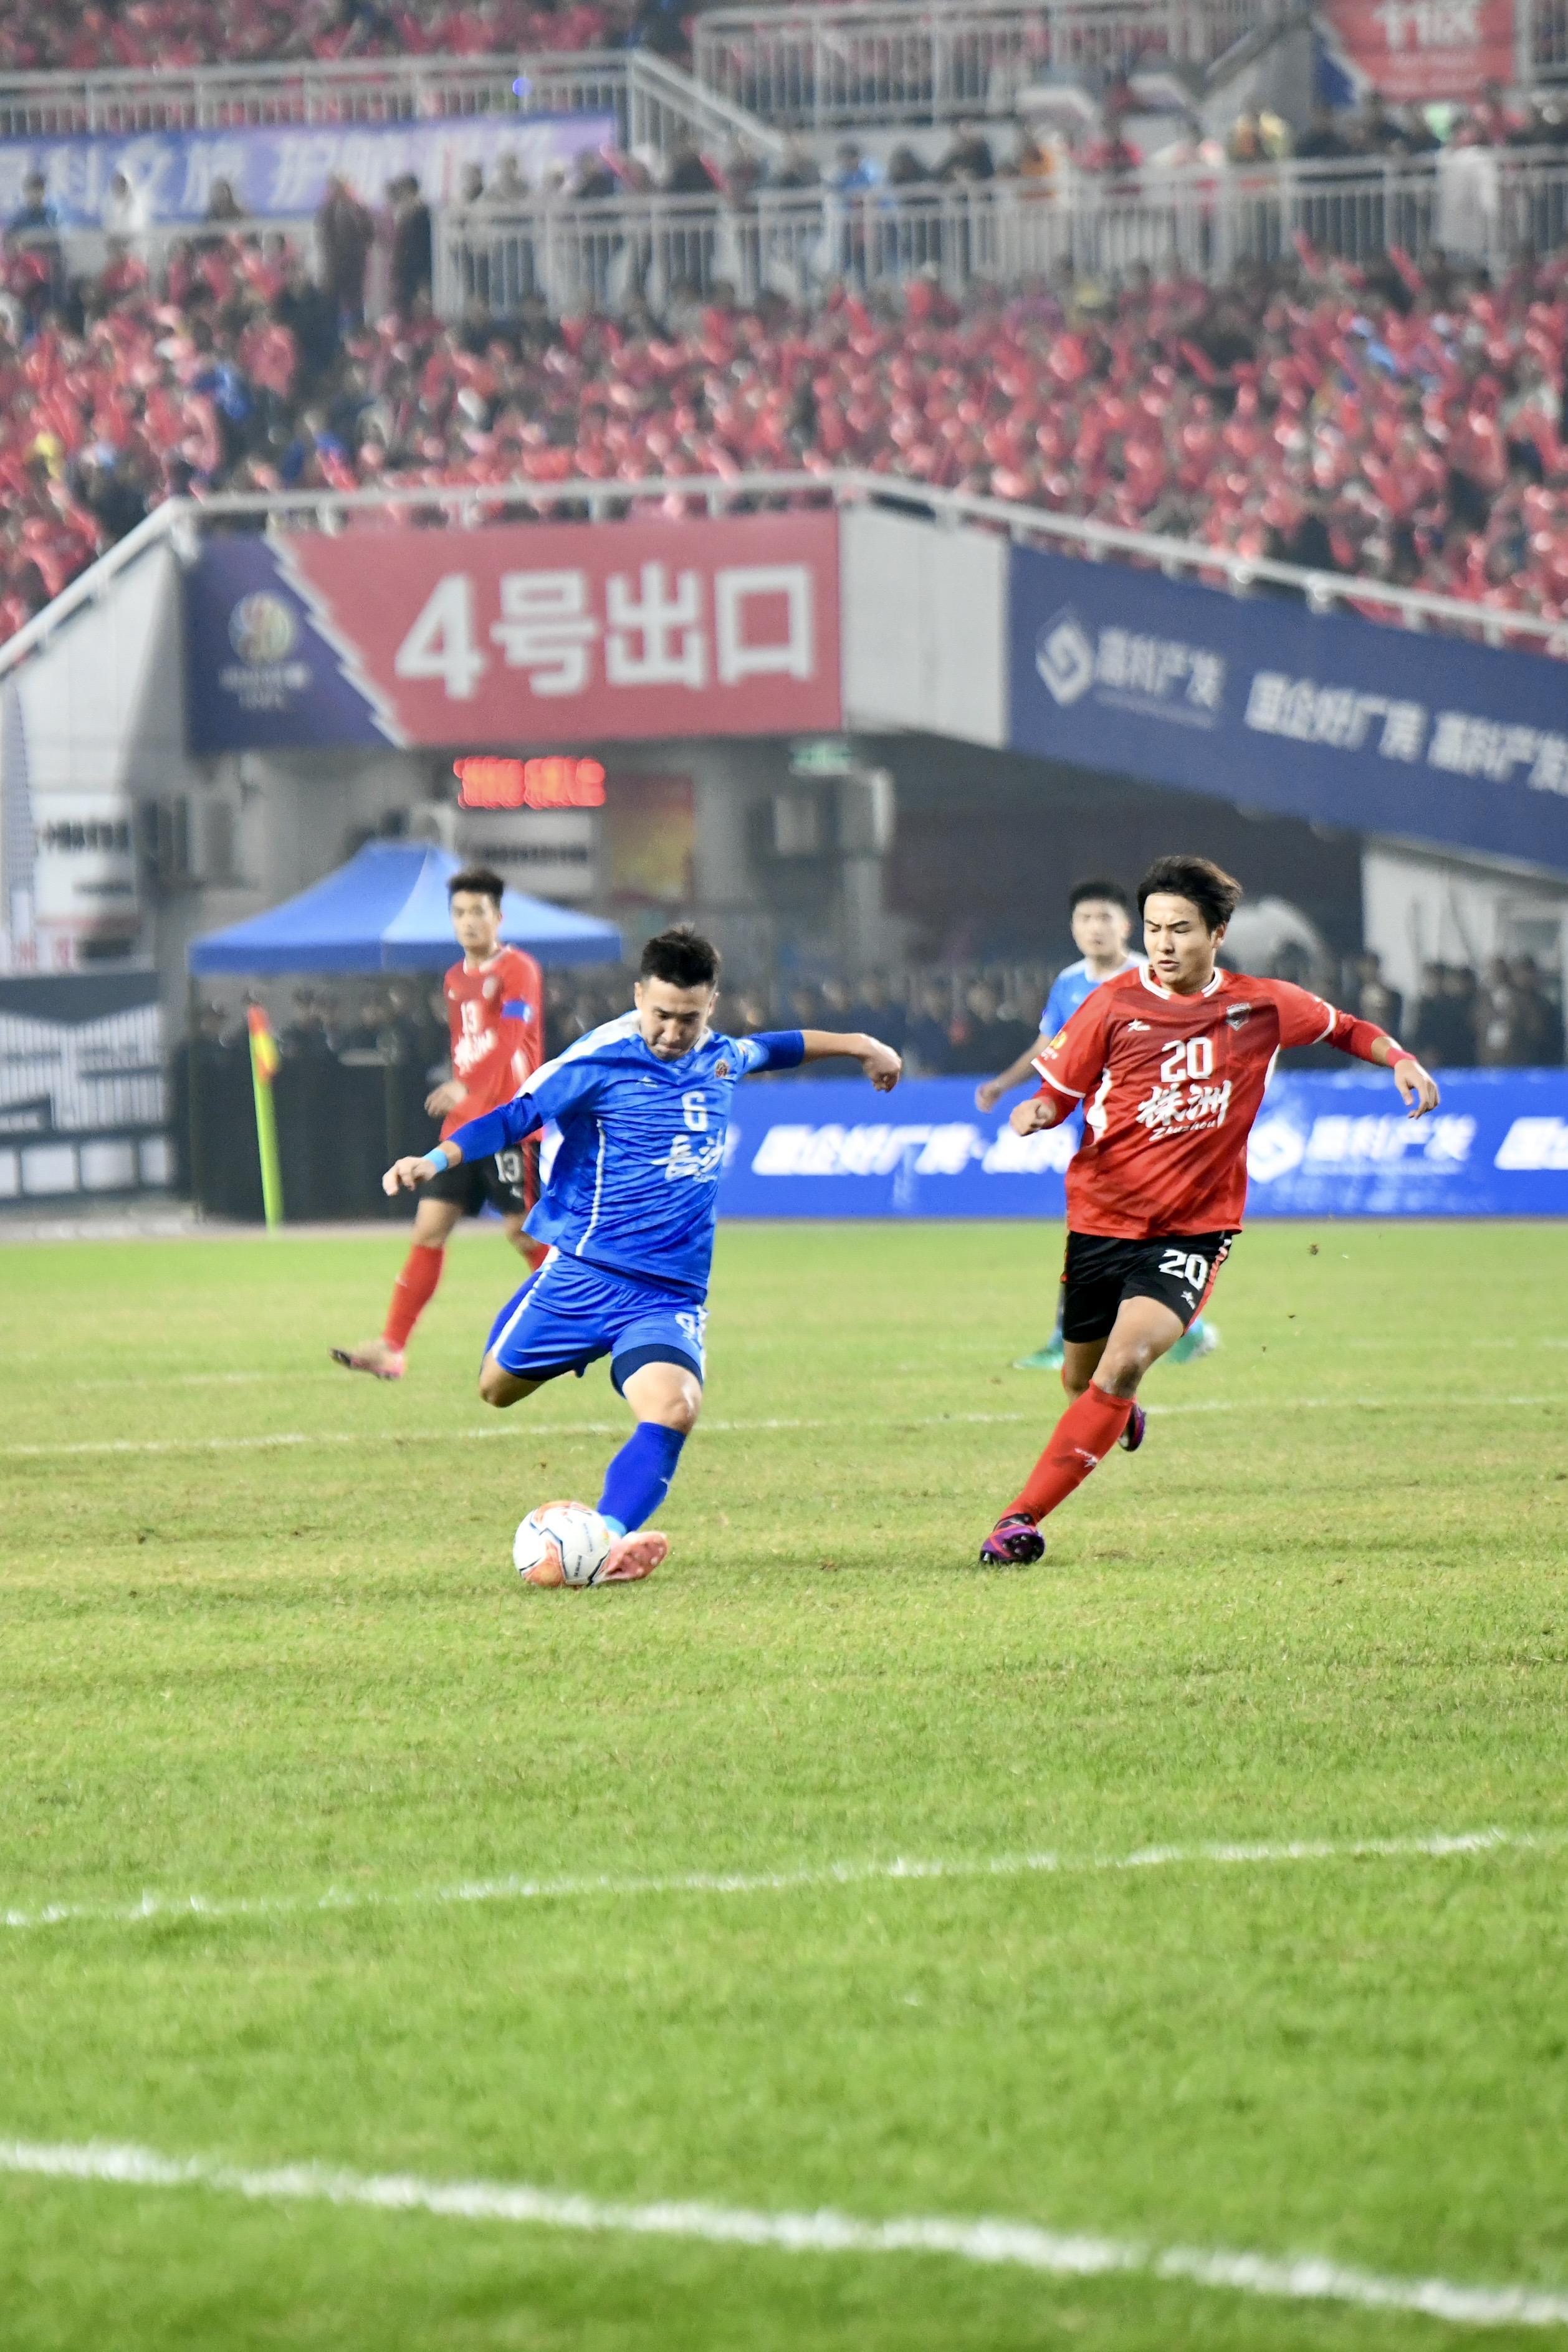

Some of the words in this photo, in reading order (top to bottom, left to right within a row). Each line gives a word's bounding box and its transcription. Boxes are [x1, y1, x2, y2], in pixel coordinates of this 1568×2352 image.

[393, 560, 812, 699] 4号出口
[461, 1000, 480, 1036] 13
[1160, 1036, 1214, 1083] 20
[682, 1090, 709, 1132] 6
[1136, 1079, 1232, 1129] 株洲
[495, 1148, 522, 1183] 13
[1158, 1249, 1208, 1291] 20
